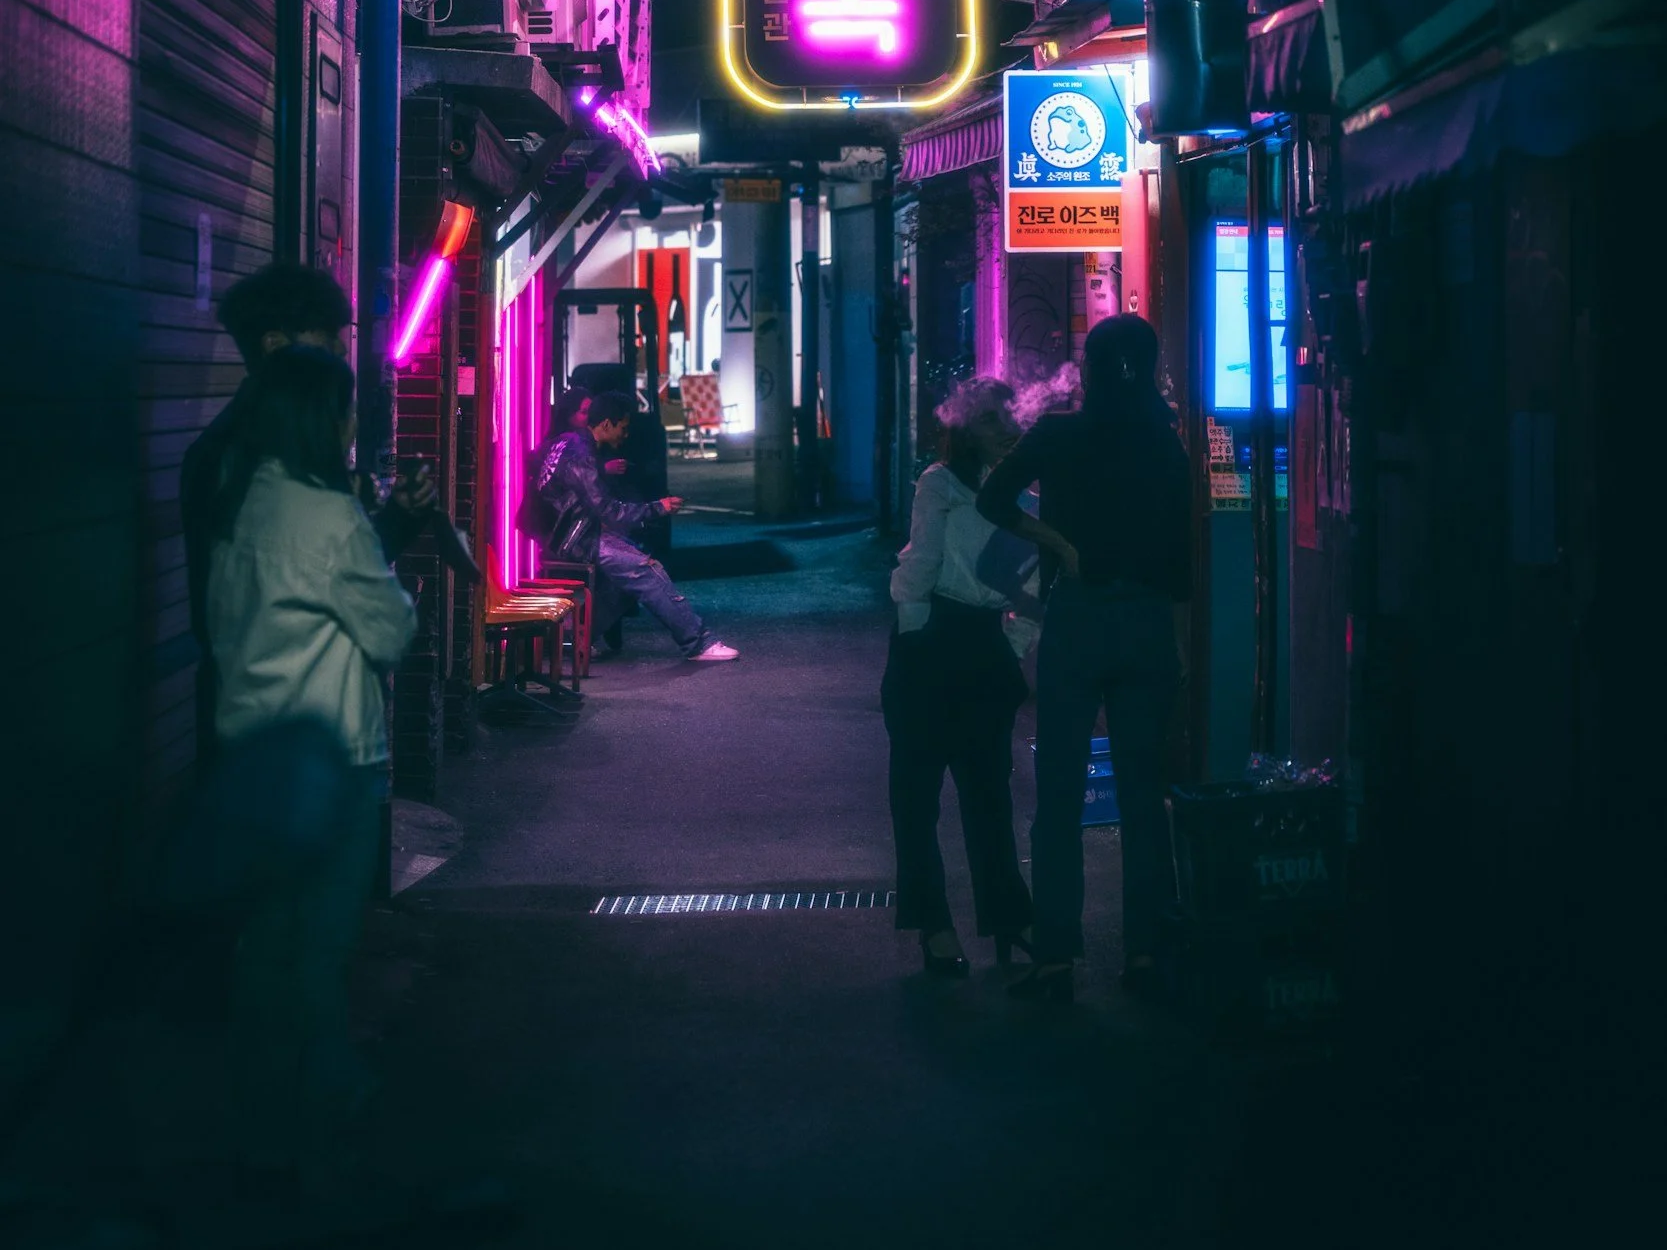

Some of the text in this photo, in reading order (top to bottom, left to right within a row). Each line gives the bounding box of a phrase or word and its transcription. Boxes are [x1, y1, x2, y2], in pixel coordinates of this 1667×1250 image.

[1047, 171, 1091, 181] 소주의 원조
[1018, 205, 1120, 225] 진로 이즈 백
[1253, 848, 1329, 887] TERRA
